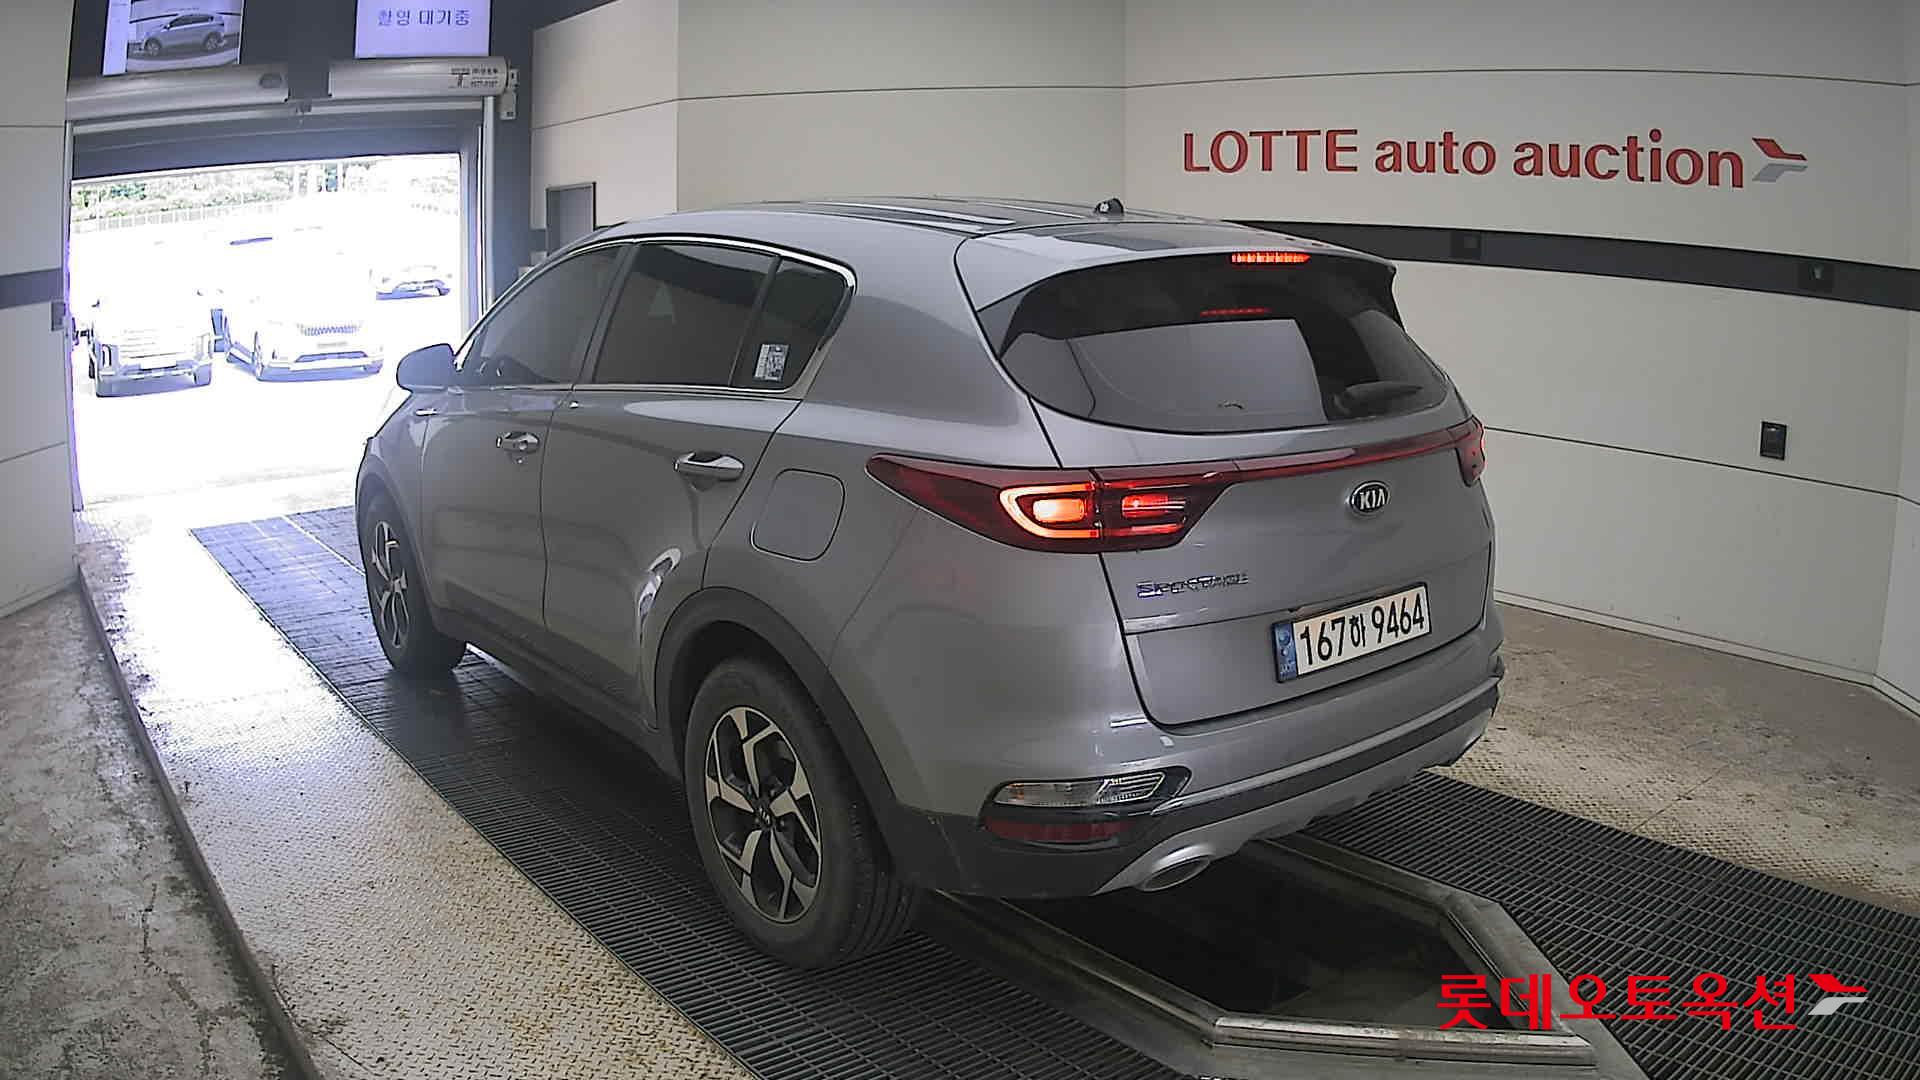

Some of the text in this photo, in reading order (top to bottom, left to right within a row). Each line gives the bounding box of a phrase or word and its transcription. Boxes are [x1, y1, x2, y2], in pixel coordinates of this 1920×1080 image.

[418, 9, 470, 26] 대기중
[1183, 128, 1744, 188] LOTTE auto auction
[1300, 593, 1425, 666] 167하 9464
